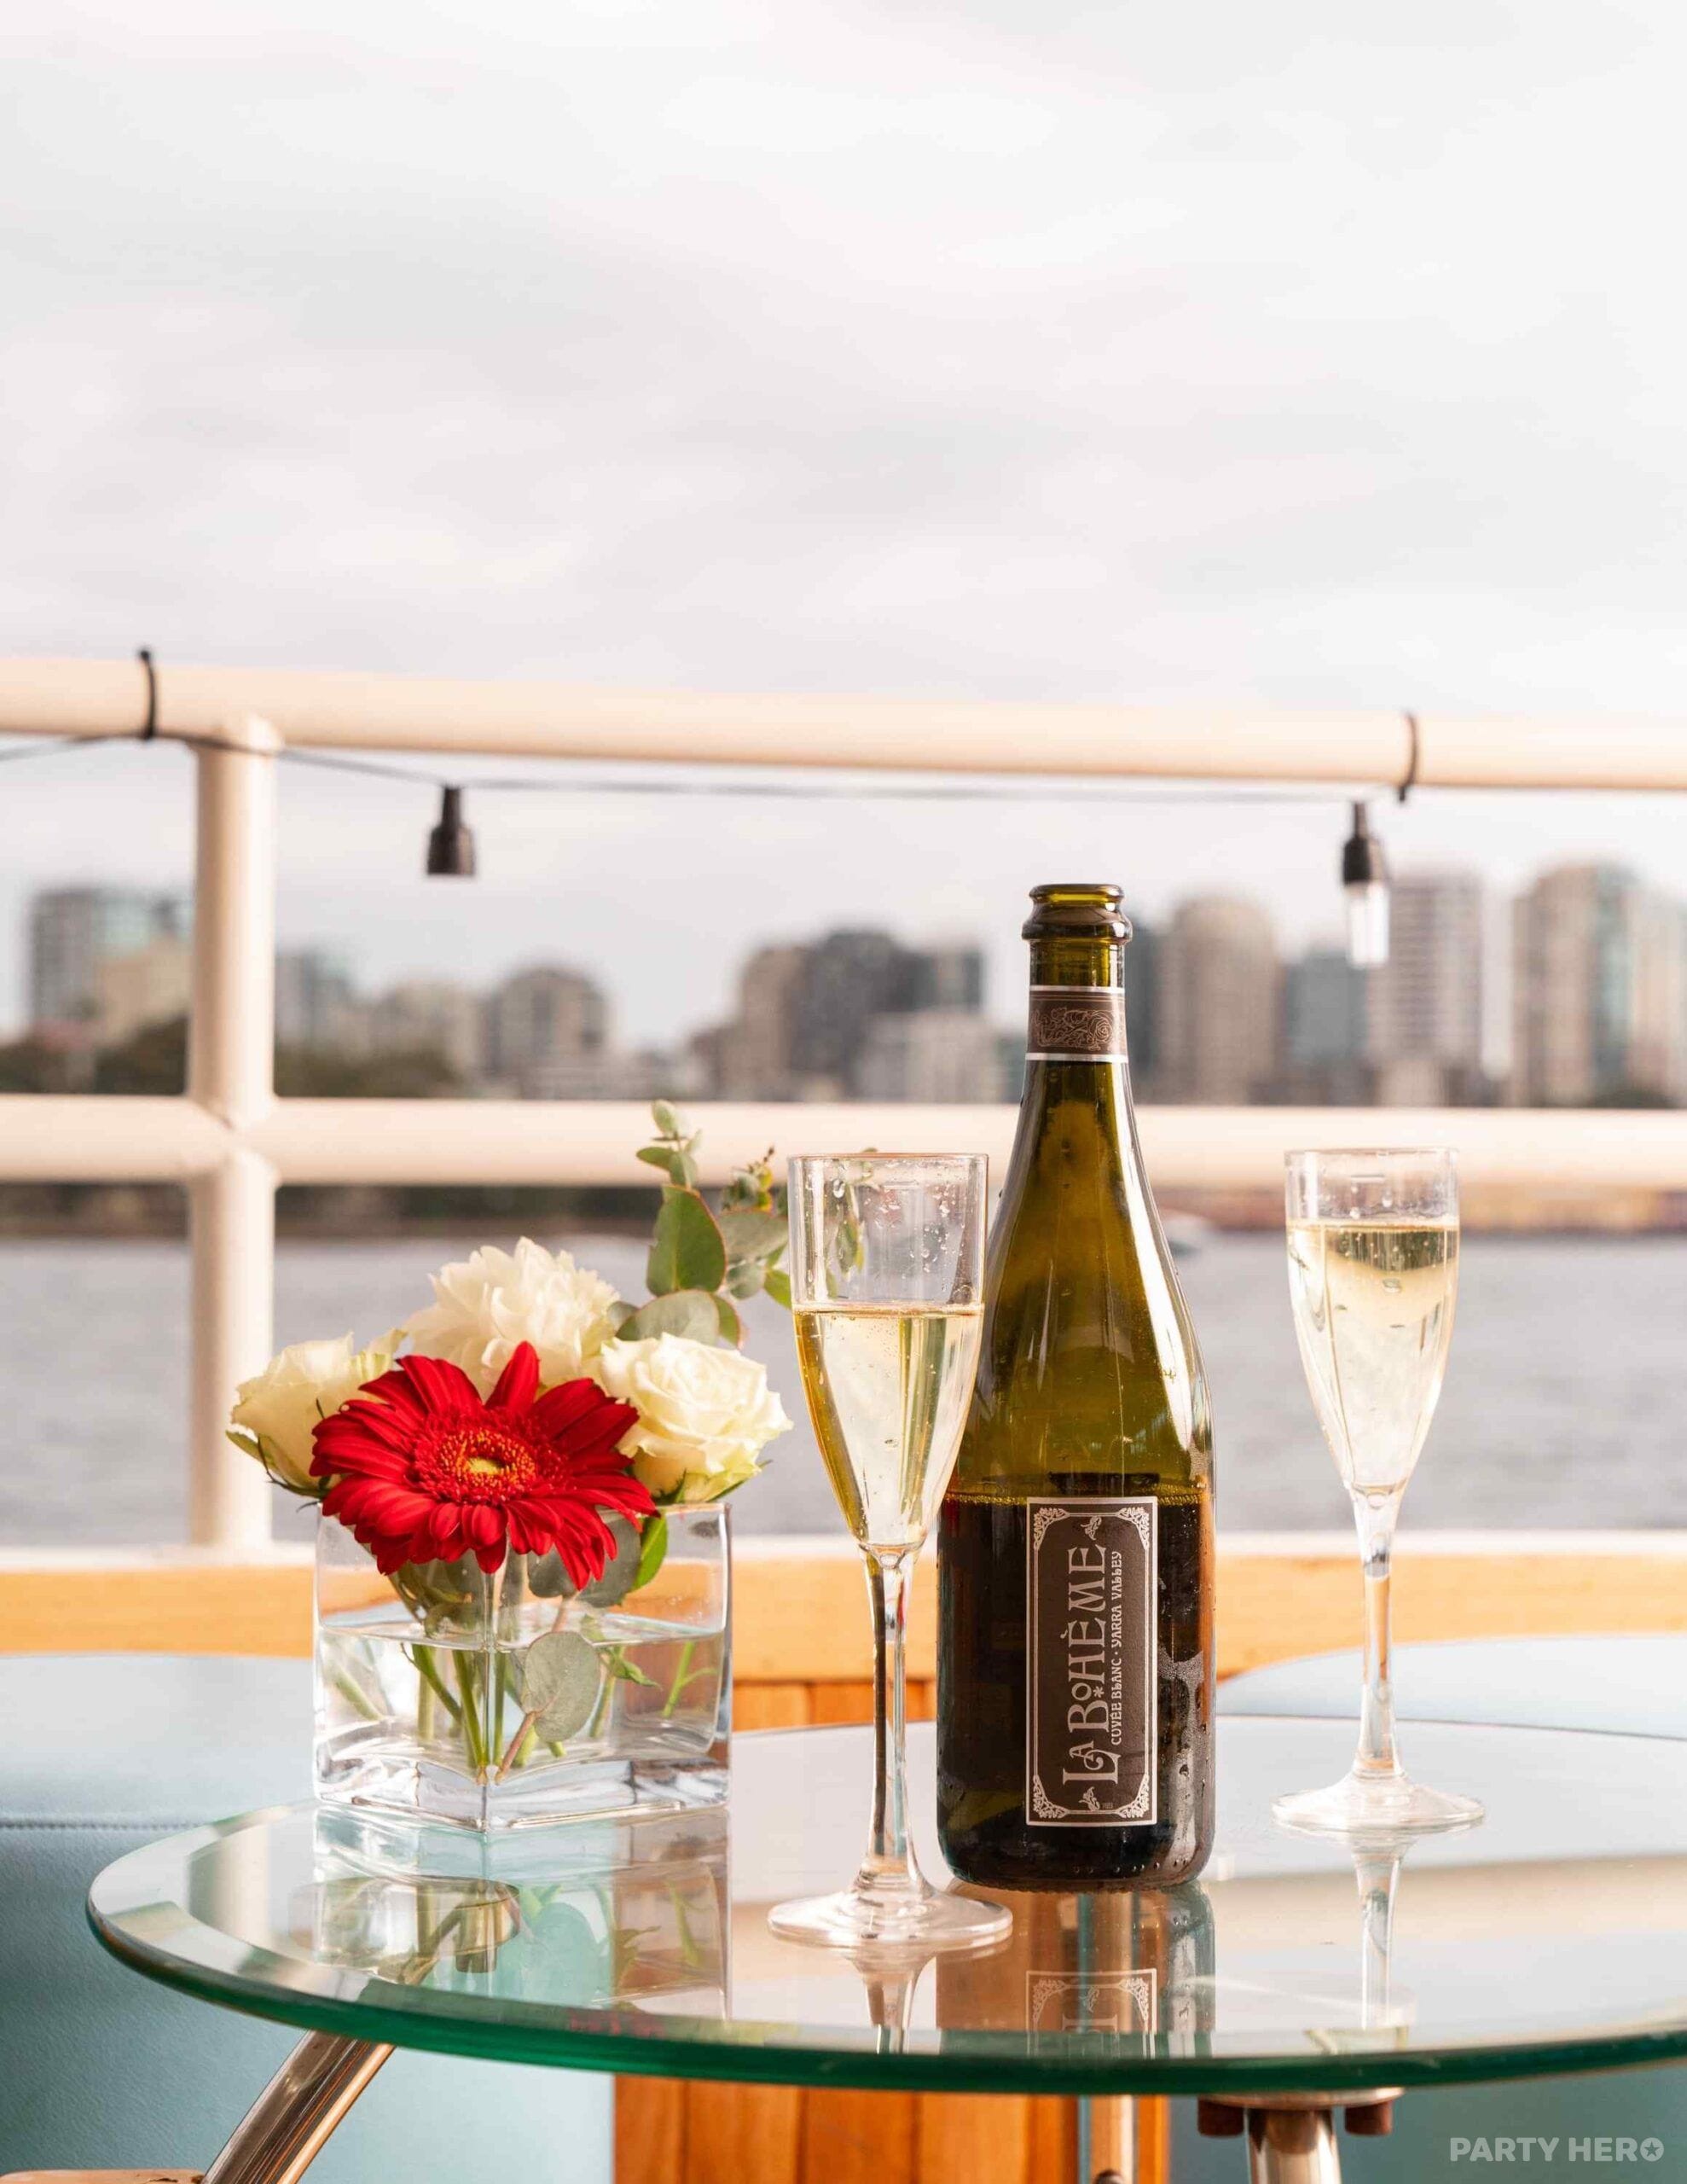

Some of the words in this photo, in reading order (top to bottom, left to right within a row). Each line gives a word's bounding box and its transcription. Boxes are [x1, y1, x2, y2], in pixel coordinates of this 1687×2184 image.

[1110, 1550, 1122, 1600] VALLEY
[1110, 1604, 1122, 1648] YARRA
[1110, 1658, 1122, 1699] BLANC
